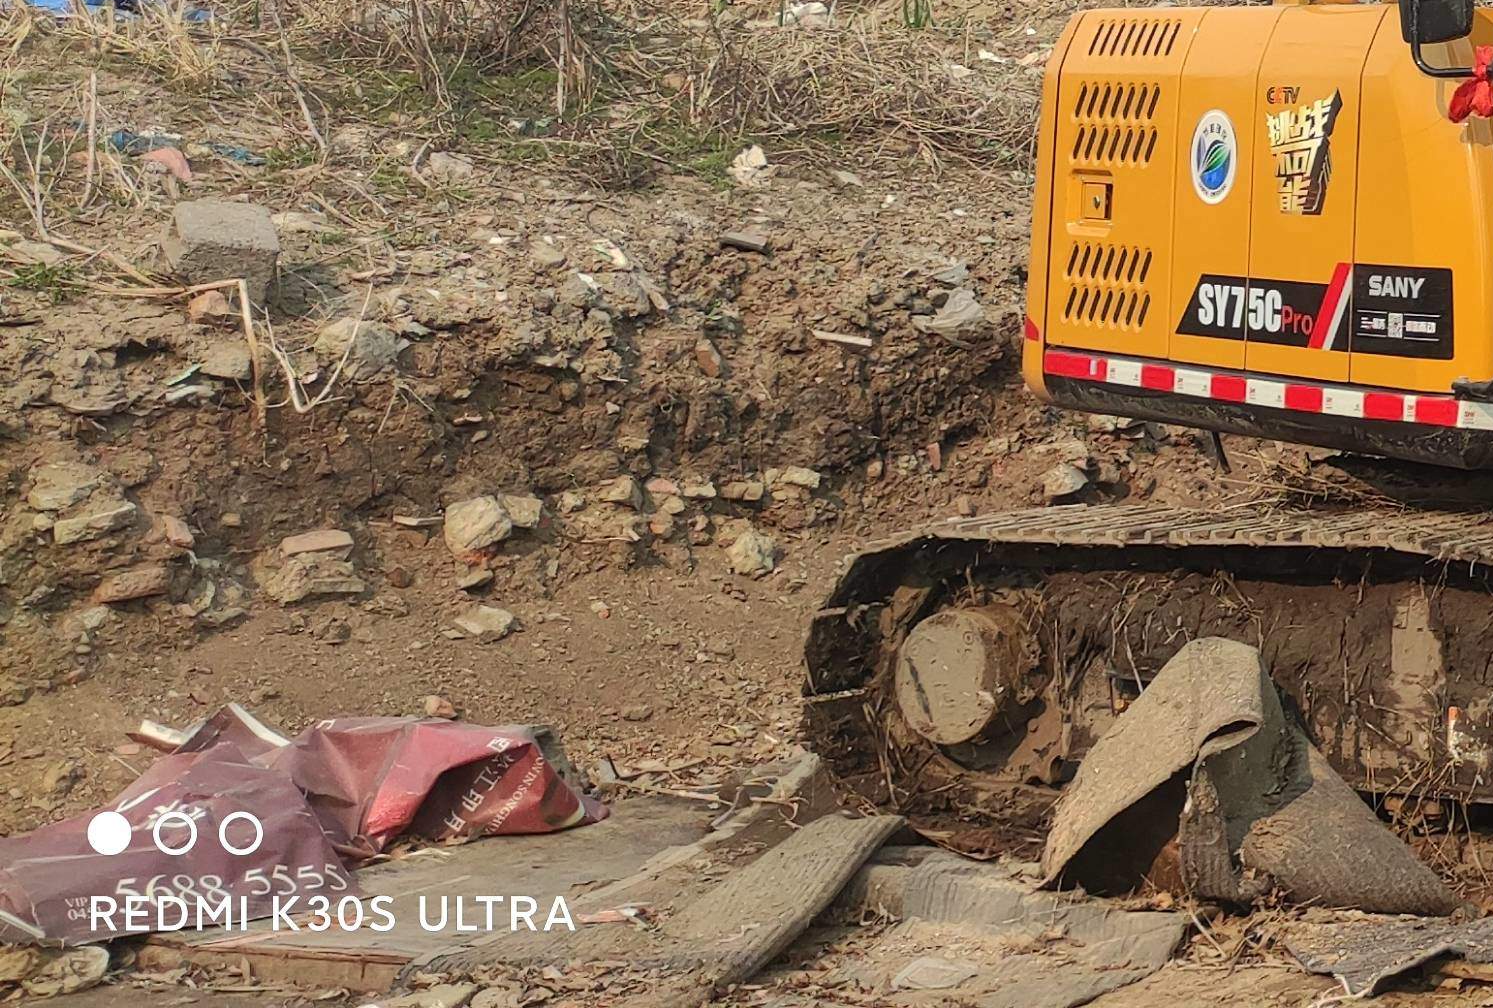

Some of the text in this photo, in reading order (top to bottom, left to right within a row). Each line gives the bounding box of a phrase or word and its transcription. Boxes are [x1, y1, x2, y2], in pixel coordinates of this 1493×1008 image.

[1266, 86, 1301, 105] CCTV
[1368, 274, 1426, 299] SANY
[244, 863, 348, 897] 5555
